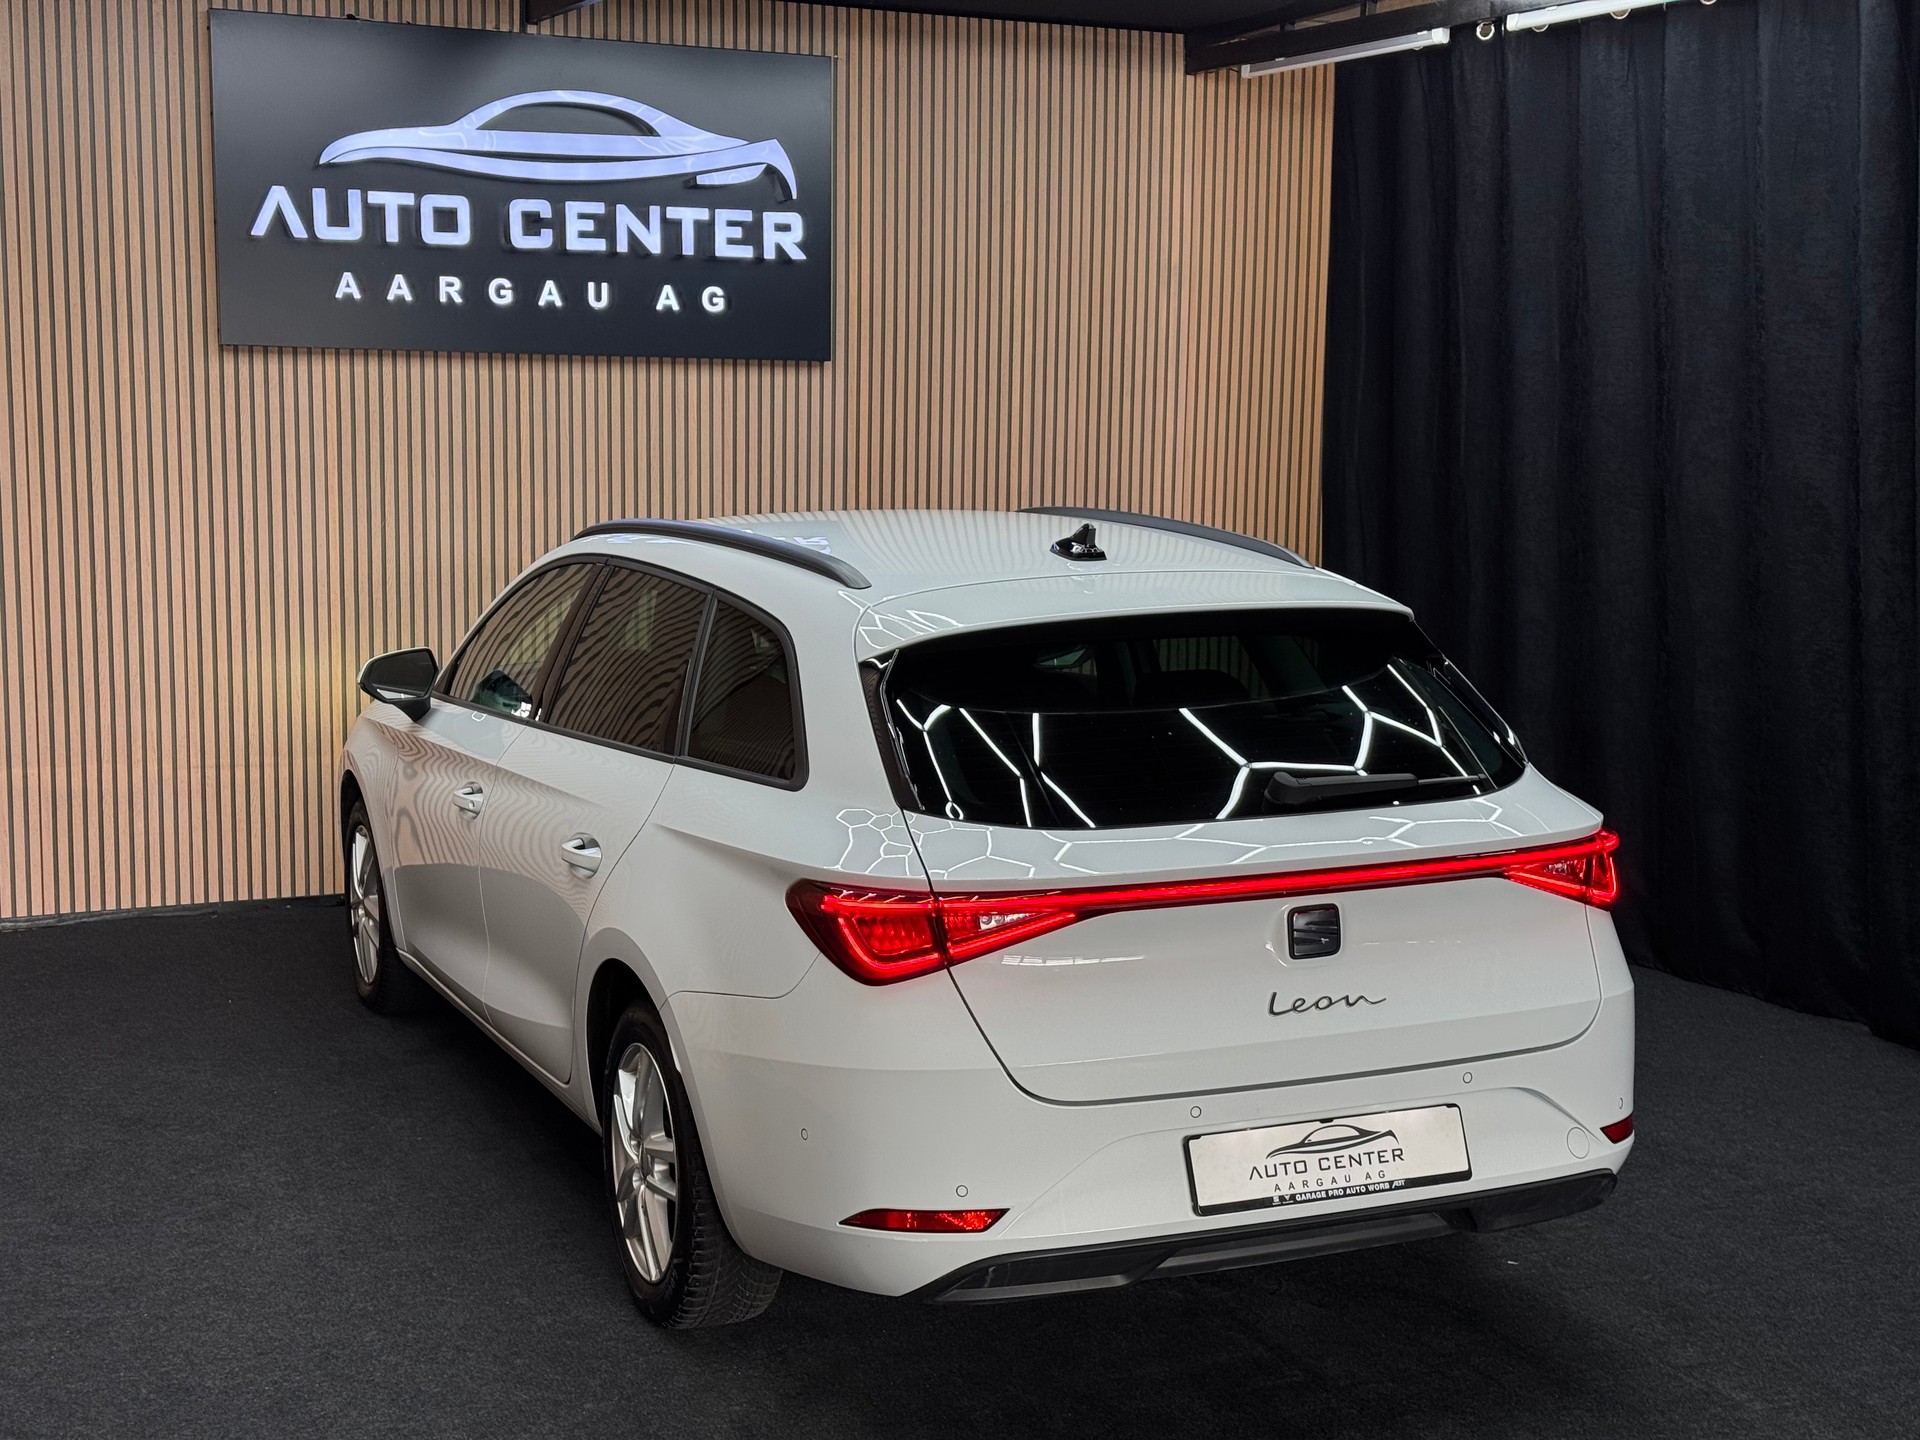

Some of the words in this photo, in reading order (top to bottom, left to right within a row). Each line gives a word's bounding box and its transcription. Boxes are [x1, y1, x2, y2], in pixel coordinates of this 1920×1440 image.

[250, 186, 470, 245] AUTO
[509, 198, 808, 260] CENTER
[335, 272, 610, 310] AARGAU
[656, 283, 729, 314] AG
[1268, 991, 1387, 1016] Leon
[1249, 1160, 1308, 1181] AUTO
[1318, 1148, 1405, 1172] CENTER
[1273, 1174, 1352, 1193] AARGAU
[1364, 1170, 1386, 1181] AG
[1295, 1190, 1327, 1202] GARAGE
[1328, 1188, 1344, 1197] PRO
[1346, 1185, 1366, 1195] AUTO
[1367, 1182, 1390, 1192] WORB
